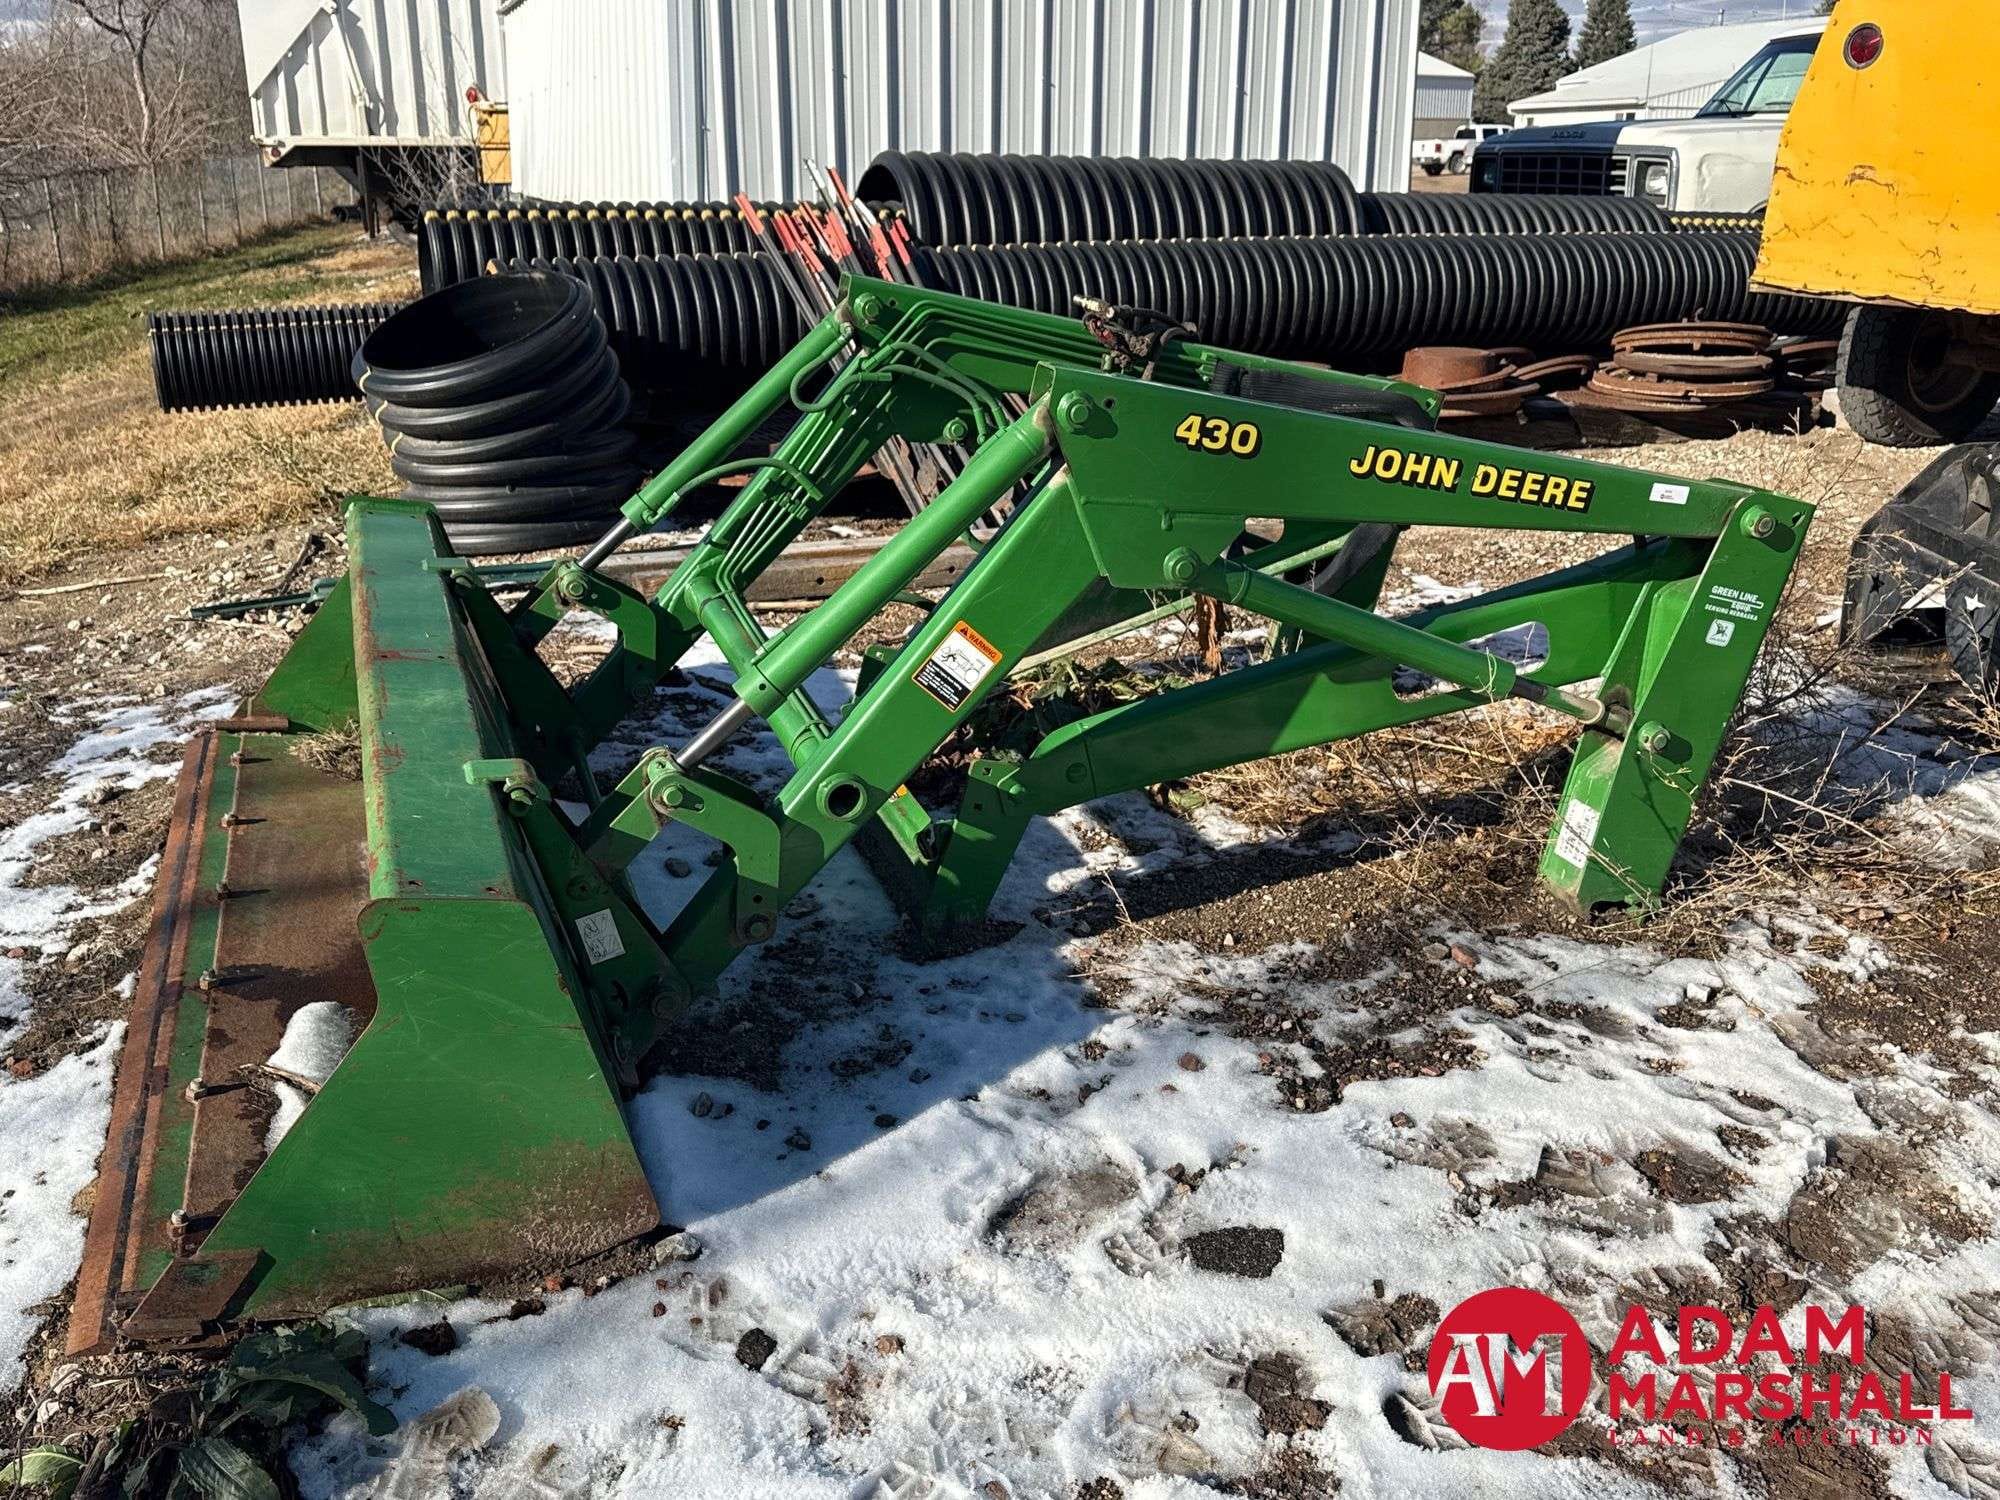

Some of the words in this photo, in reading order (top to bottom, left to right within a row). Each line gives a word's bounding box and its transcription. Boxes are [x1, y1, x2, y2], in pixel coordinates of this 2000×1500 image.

[1175, 414, 1262, 456] 430
[1348, 445, 1462, 491] JOHN
[1470, 464, 1594, 513] DEERE
[1711, 585, 1740, 599] GREEN
[1739, 591, 1759, 603] LINE
[1729, 609, 1759, 621] NEBRASKA
[968, 633, 998, 660] WARNING
